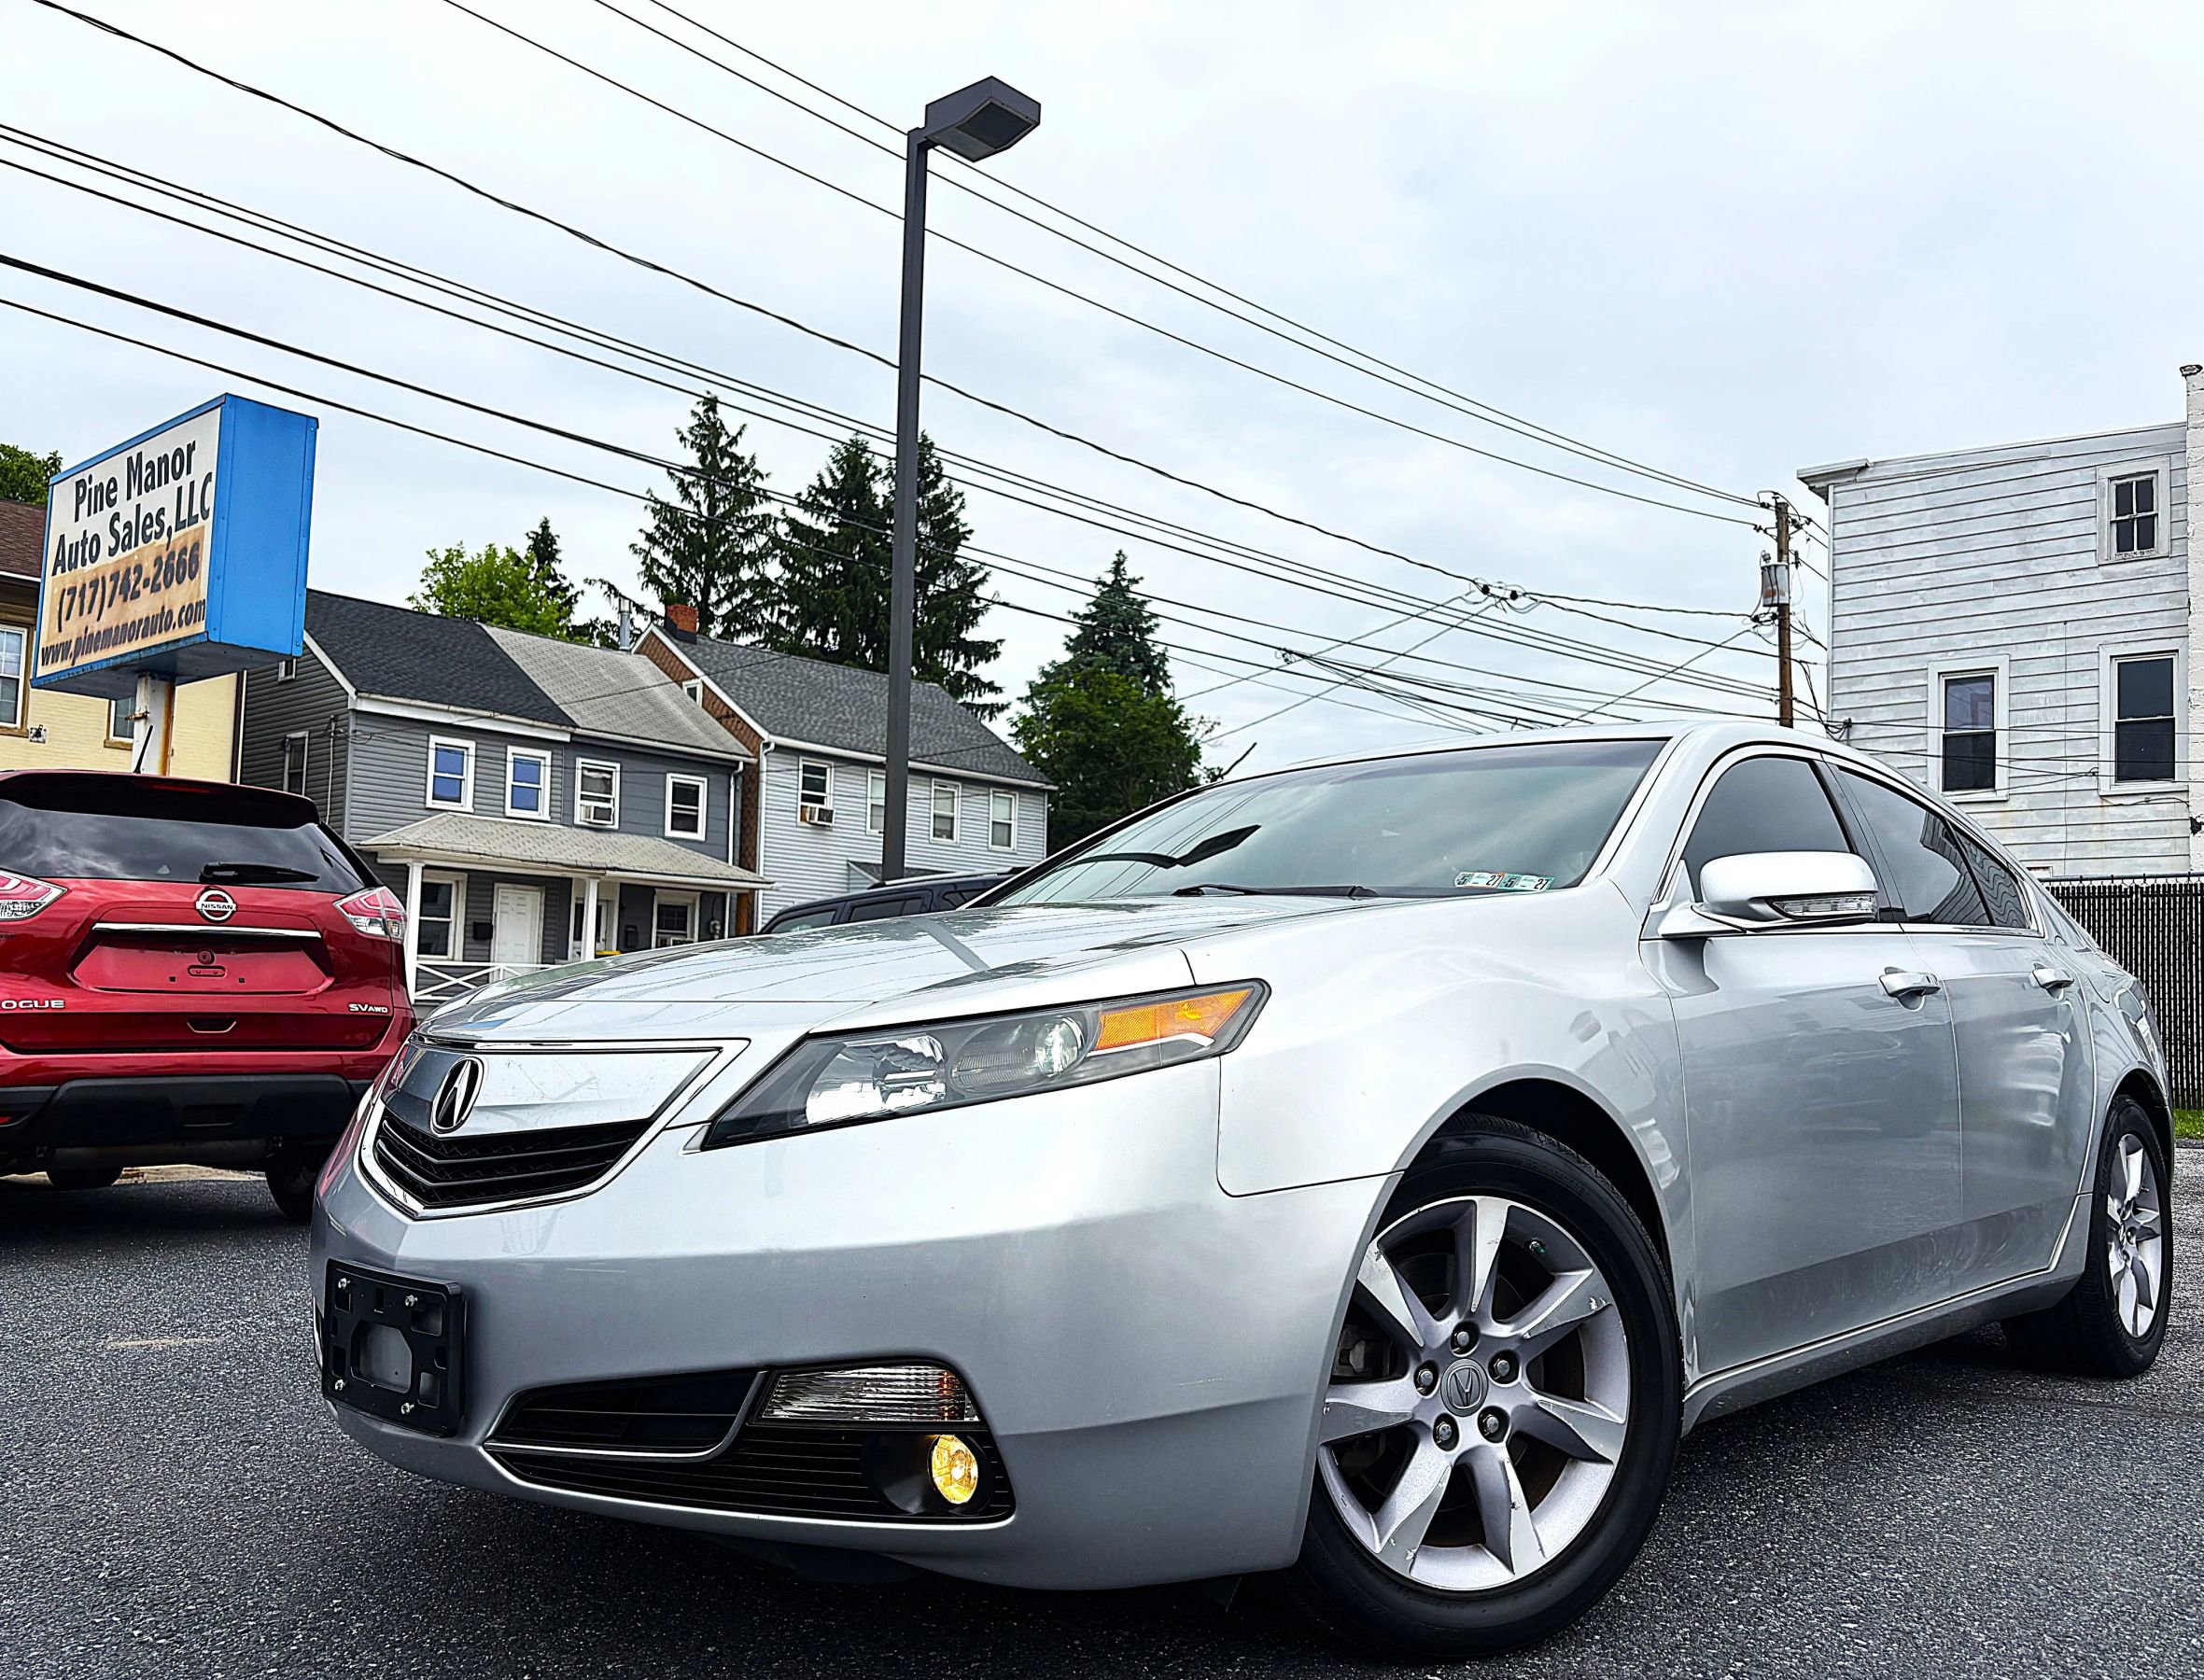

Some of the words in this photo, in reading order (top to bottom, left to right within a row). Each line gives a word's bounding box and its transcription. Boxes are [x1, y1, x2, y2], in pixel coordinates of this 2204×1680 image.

[74, 473, 118, 523] Pine
[126, 440, 196, 501] Manor
[51, 533, 101, 576] Auto
[107, 471, 213, 552] Sales,LLC
[57, 541, 201, 633] (717)742-2666
[41, 598, 206, 666] www.pinemanorauto.com
[1485, 875, 1501, 886] 27
[1533, 878, 1550, 890] 27
